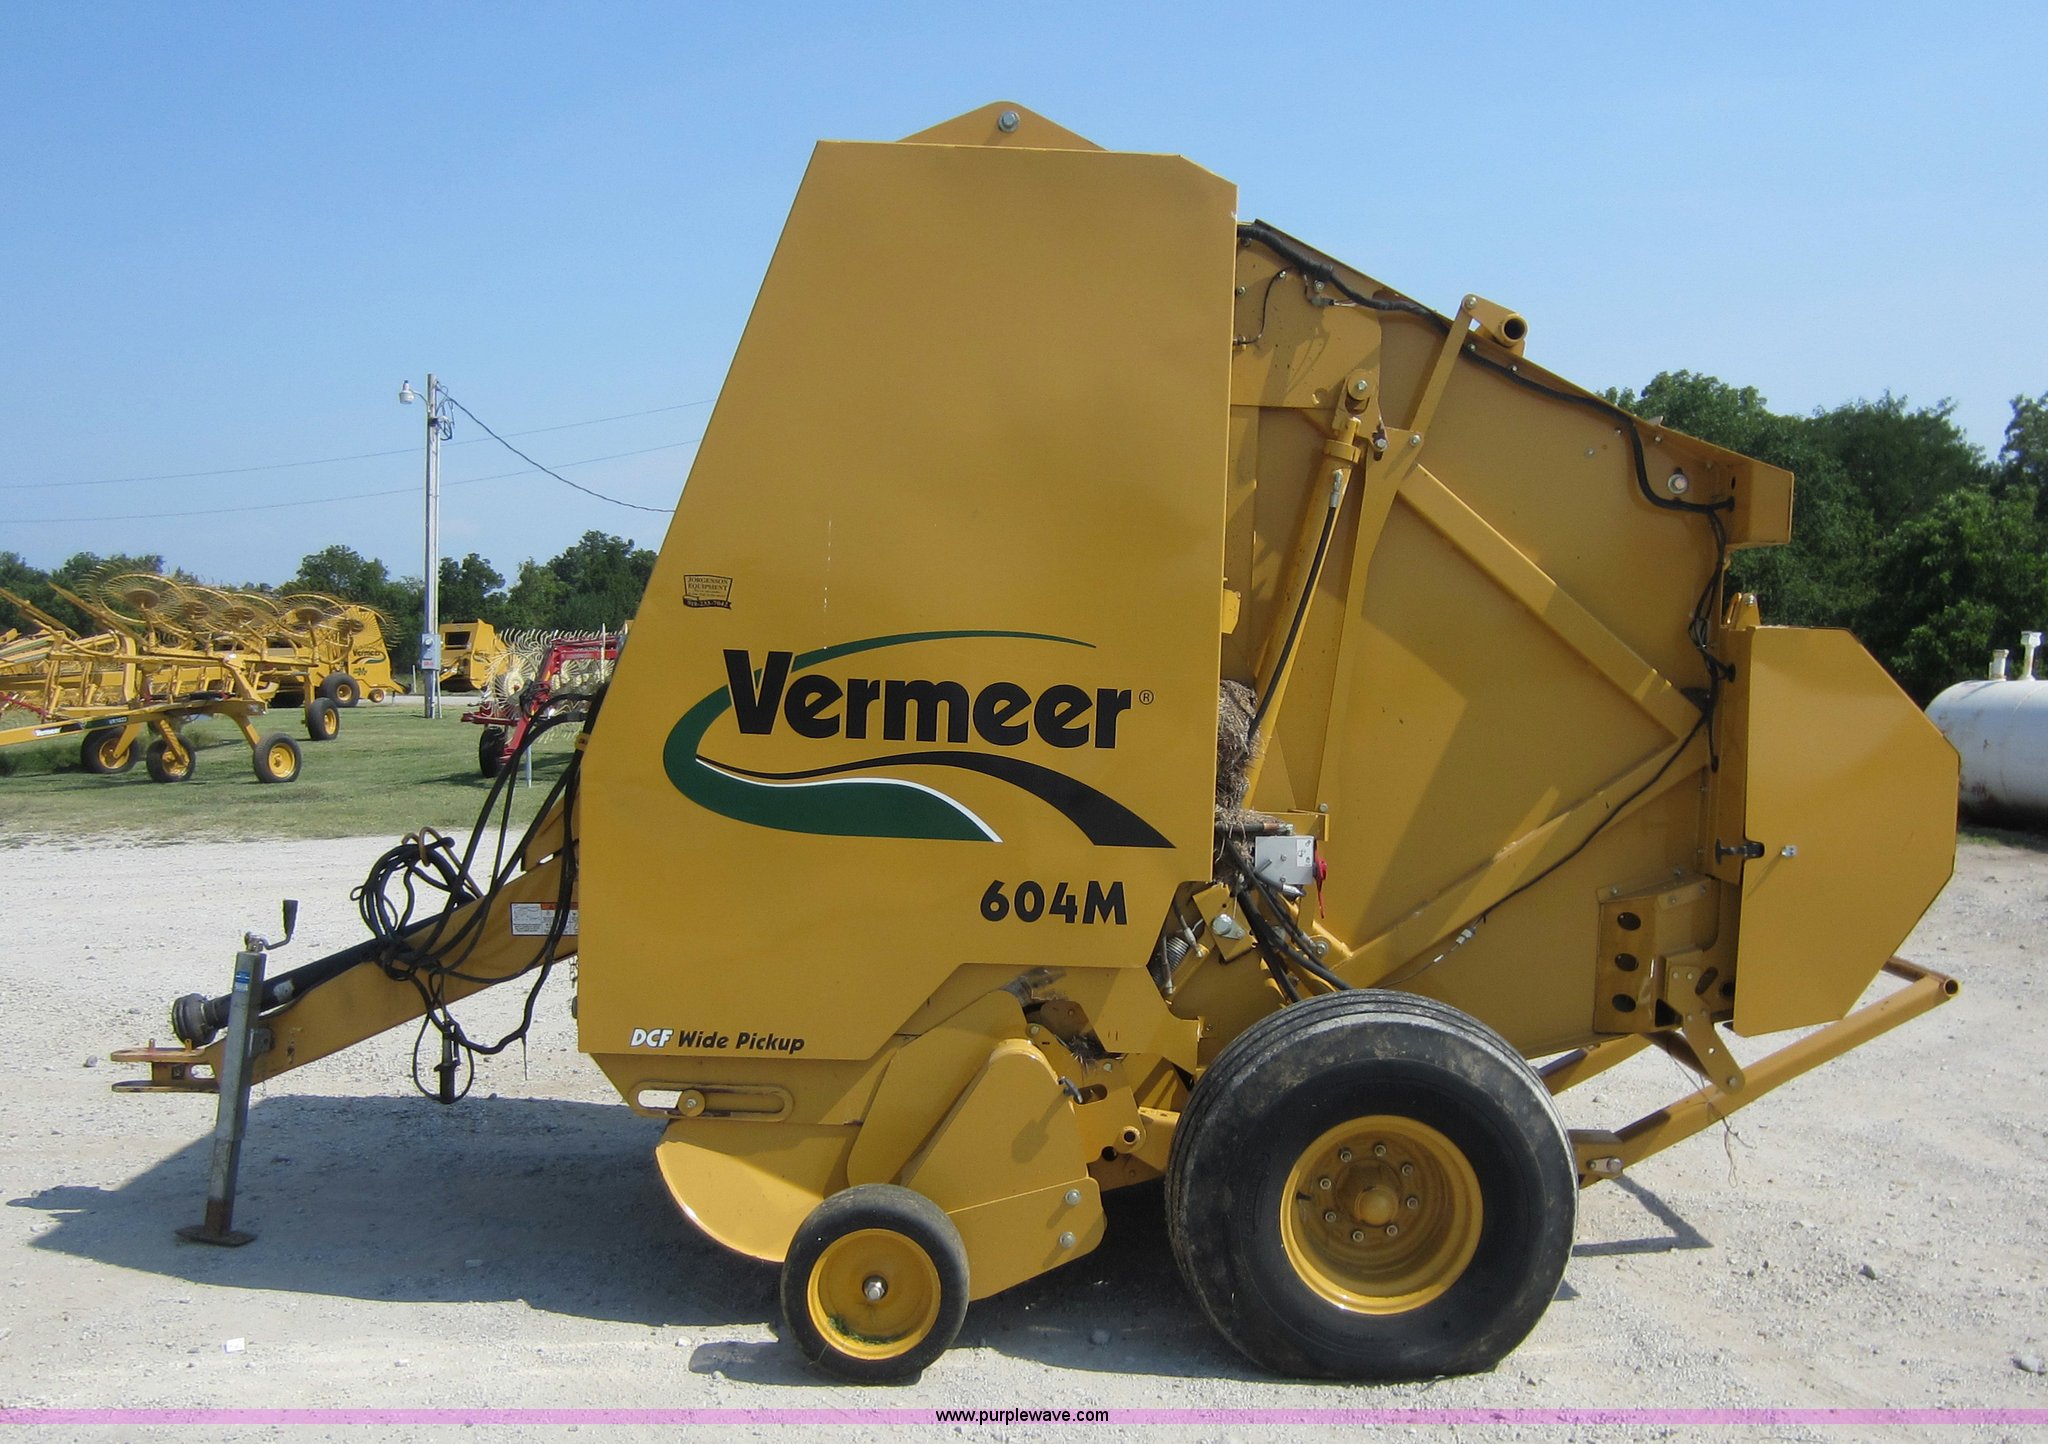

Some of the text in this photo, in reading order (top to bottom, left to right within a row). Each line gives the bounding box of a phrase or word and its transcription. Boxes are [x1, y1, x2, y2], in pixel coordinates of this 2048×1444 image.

[688, 583, 728, 591] EQUIPMENT
[723, 649, 1132, 749] Vermeer
[980, 879, 1128, 925] 604M
[630, 1028, 805, 1054] DCF Wide Pickup
